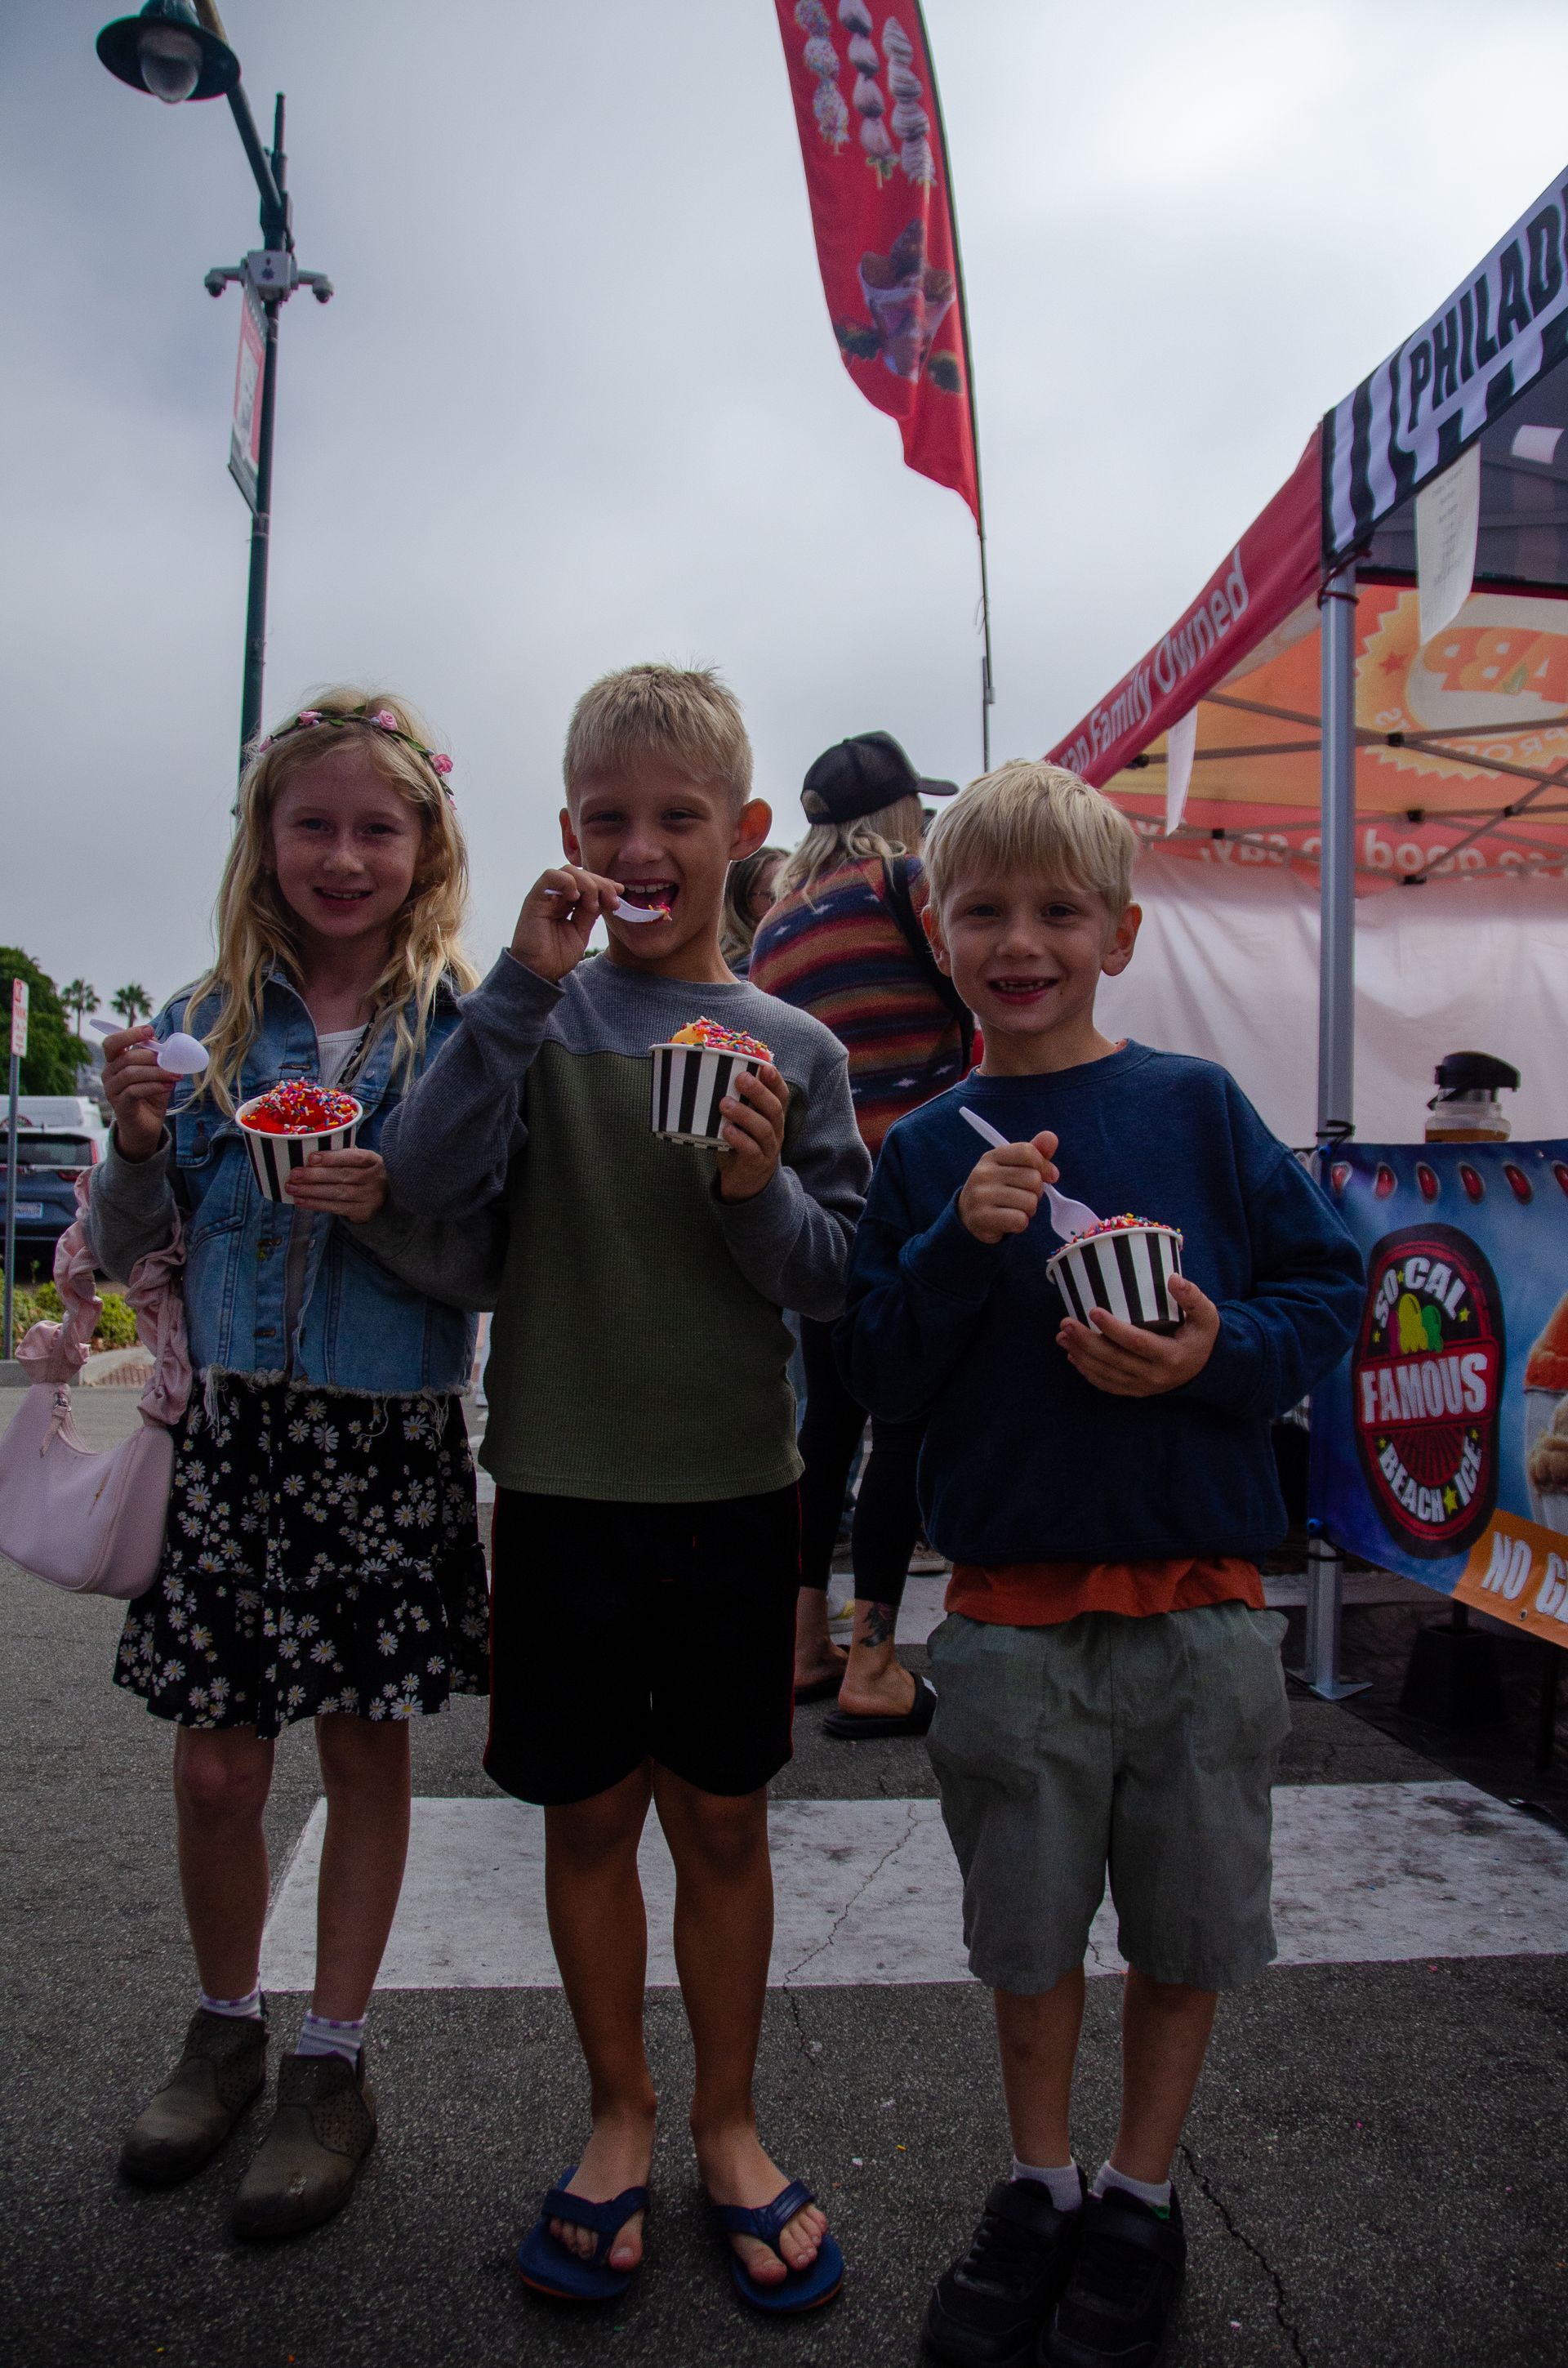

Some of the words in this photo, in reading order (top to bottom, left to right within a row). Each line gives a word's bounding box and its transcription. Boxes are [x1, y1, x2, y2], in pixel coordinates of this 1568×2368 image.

[1088, 663, 1152, 763] Family
[1153, 544, 1250, 694] Owned
[1374, 1268, 1400, 1329] SO
[1404, 1256, 1467, 1321] CAL
[1361, 1352, 1489, 1425] FAMOUS
[1379, 1441, 1446, 1523] BEACH
[1454, 1434, 1483, 1507] ICE
[1481, 1530, 1533, 1601] NO
